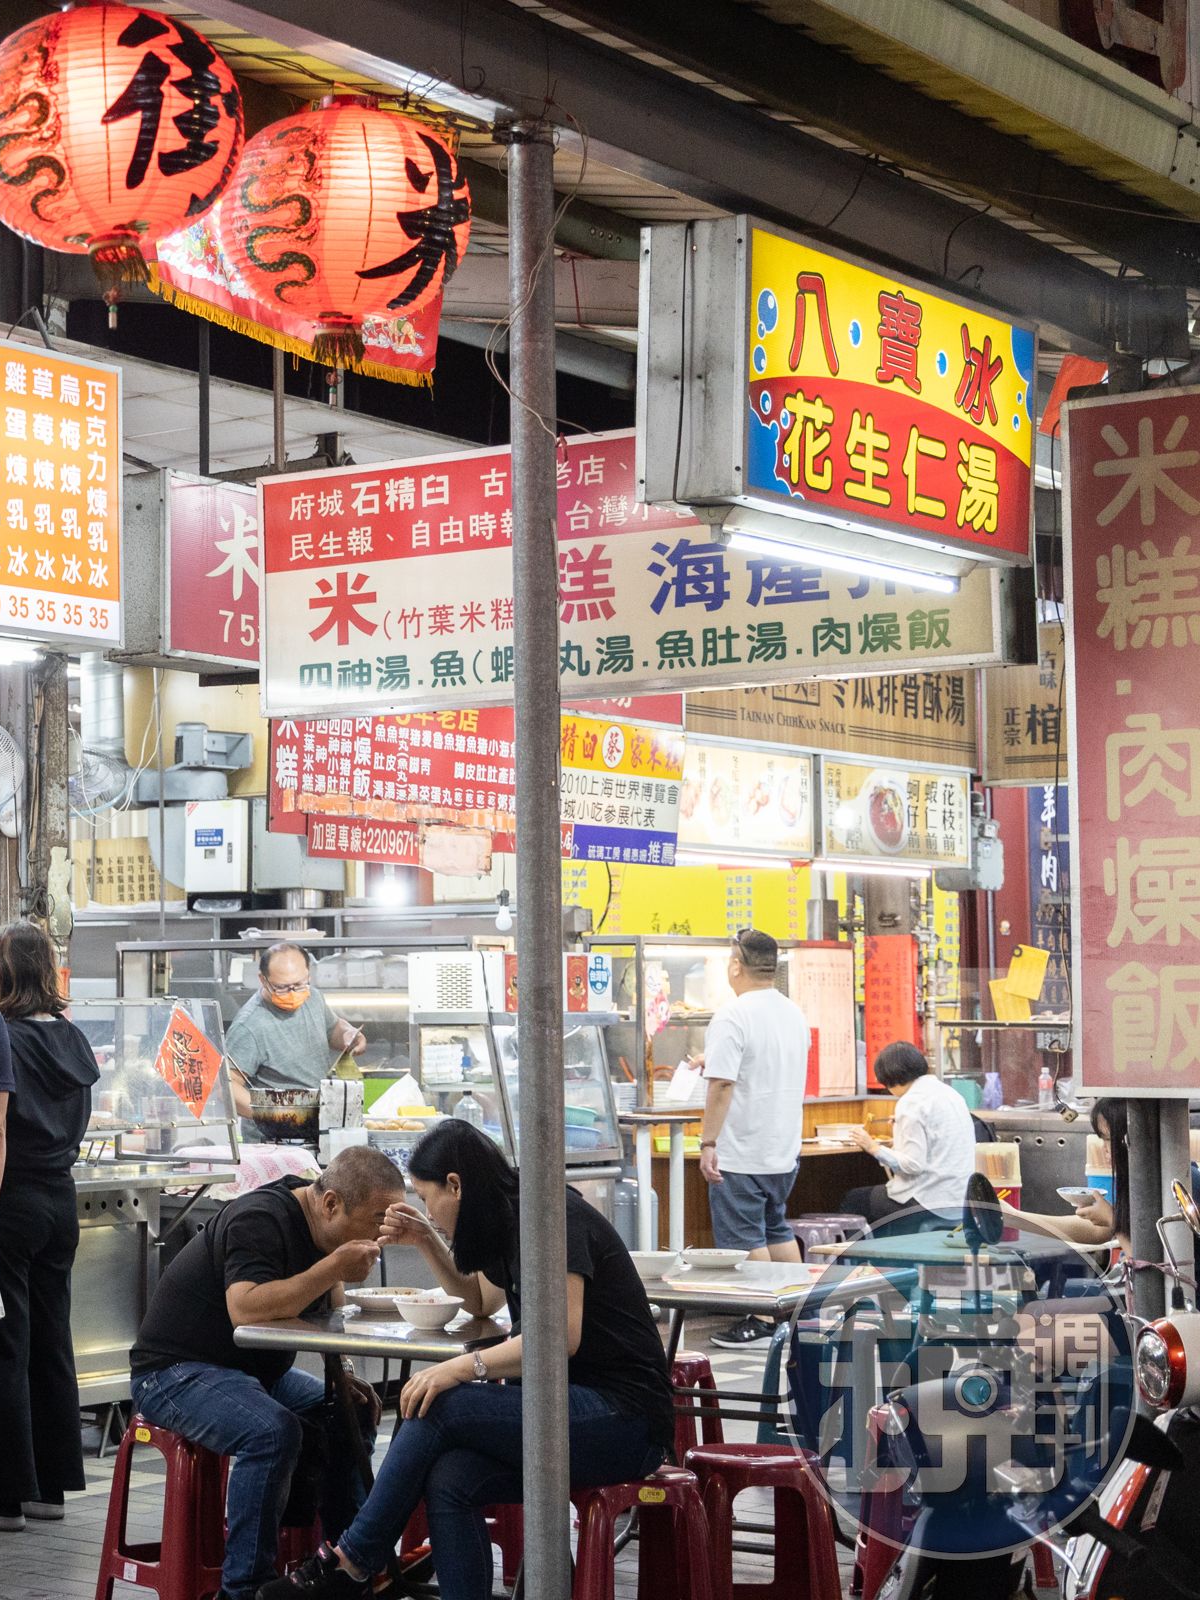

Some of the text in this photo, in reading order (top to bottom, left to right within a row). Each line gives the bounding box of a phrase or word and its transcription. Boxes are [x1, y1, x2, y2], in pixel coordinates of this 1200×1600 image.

[788, 271, 1004, 426] 八寶冰
[4, 361, 29, 577] 雞蛋煉乳冰
[32, 367, 56, 581] 草莓煉乳冰
[59, 373, 83, 585] 烏梅煉乳冰
[85, 379, 109, 588] 巧克力煉乳冰
[289, 474, 450, 521] 府城石精臼
[783, 390, 1001, 534] 花生仁湯
[8, 594, 30, 619] 35
[36, 598, 57, 623] 35
[62, 602, 83, 627] 35
[89, 606, 109, 630] 35
[218, 609, 259, 648] 75
[308, 571, 379, 646] 米
[383, 597, 514, 641] (竹葉米糕
[1003, 706, 1021, 747] 正宗
[561, 797, 656, 828] 城小吃參展代表
